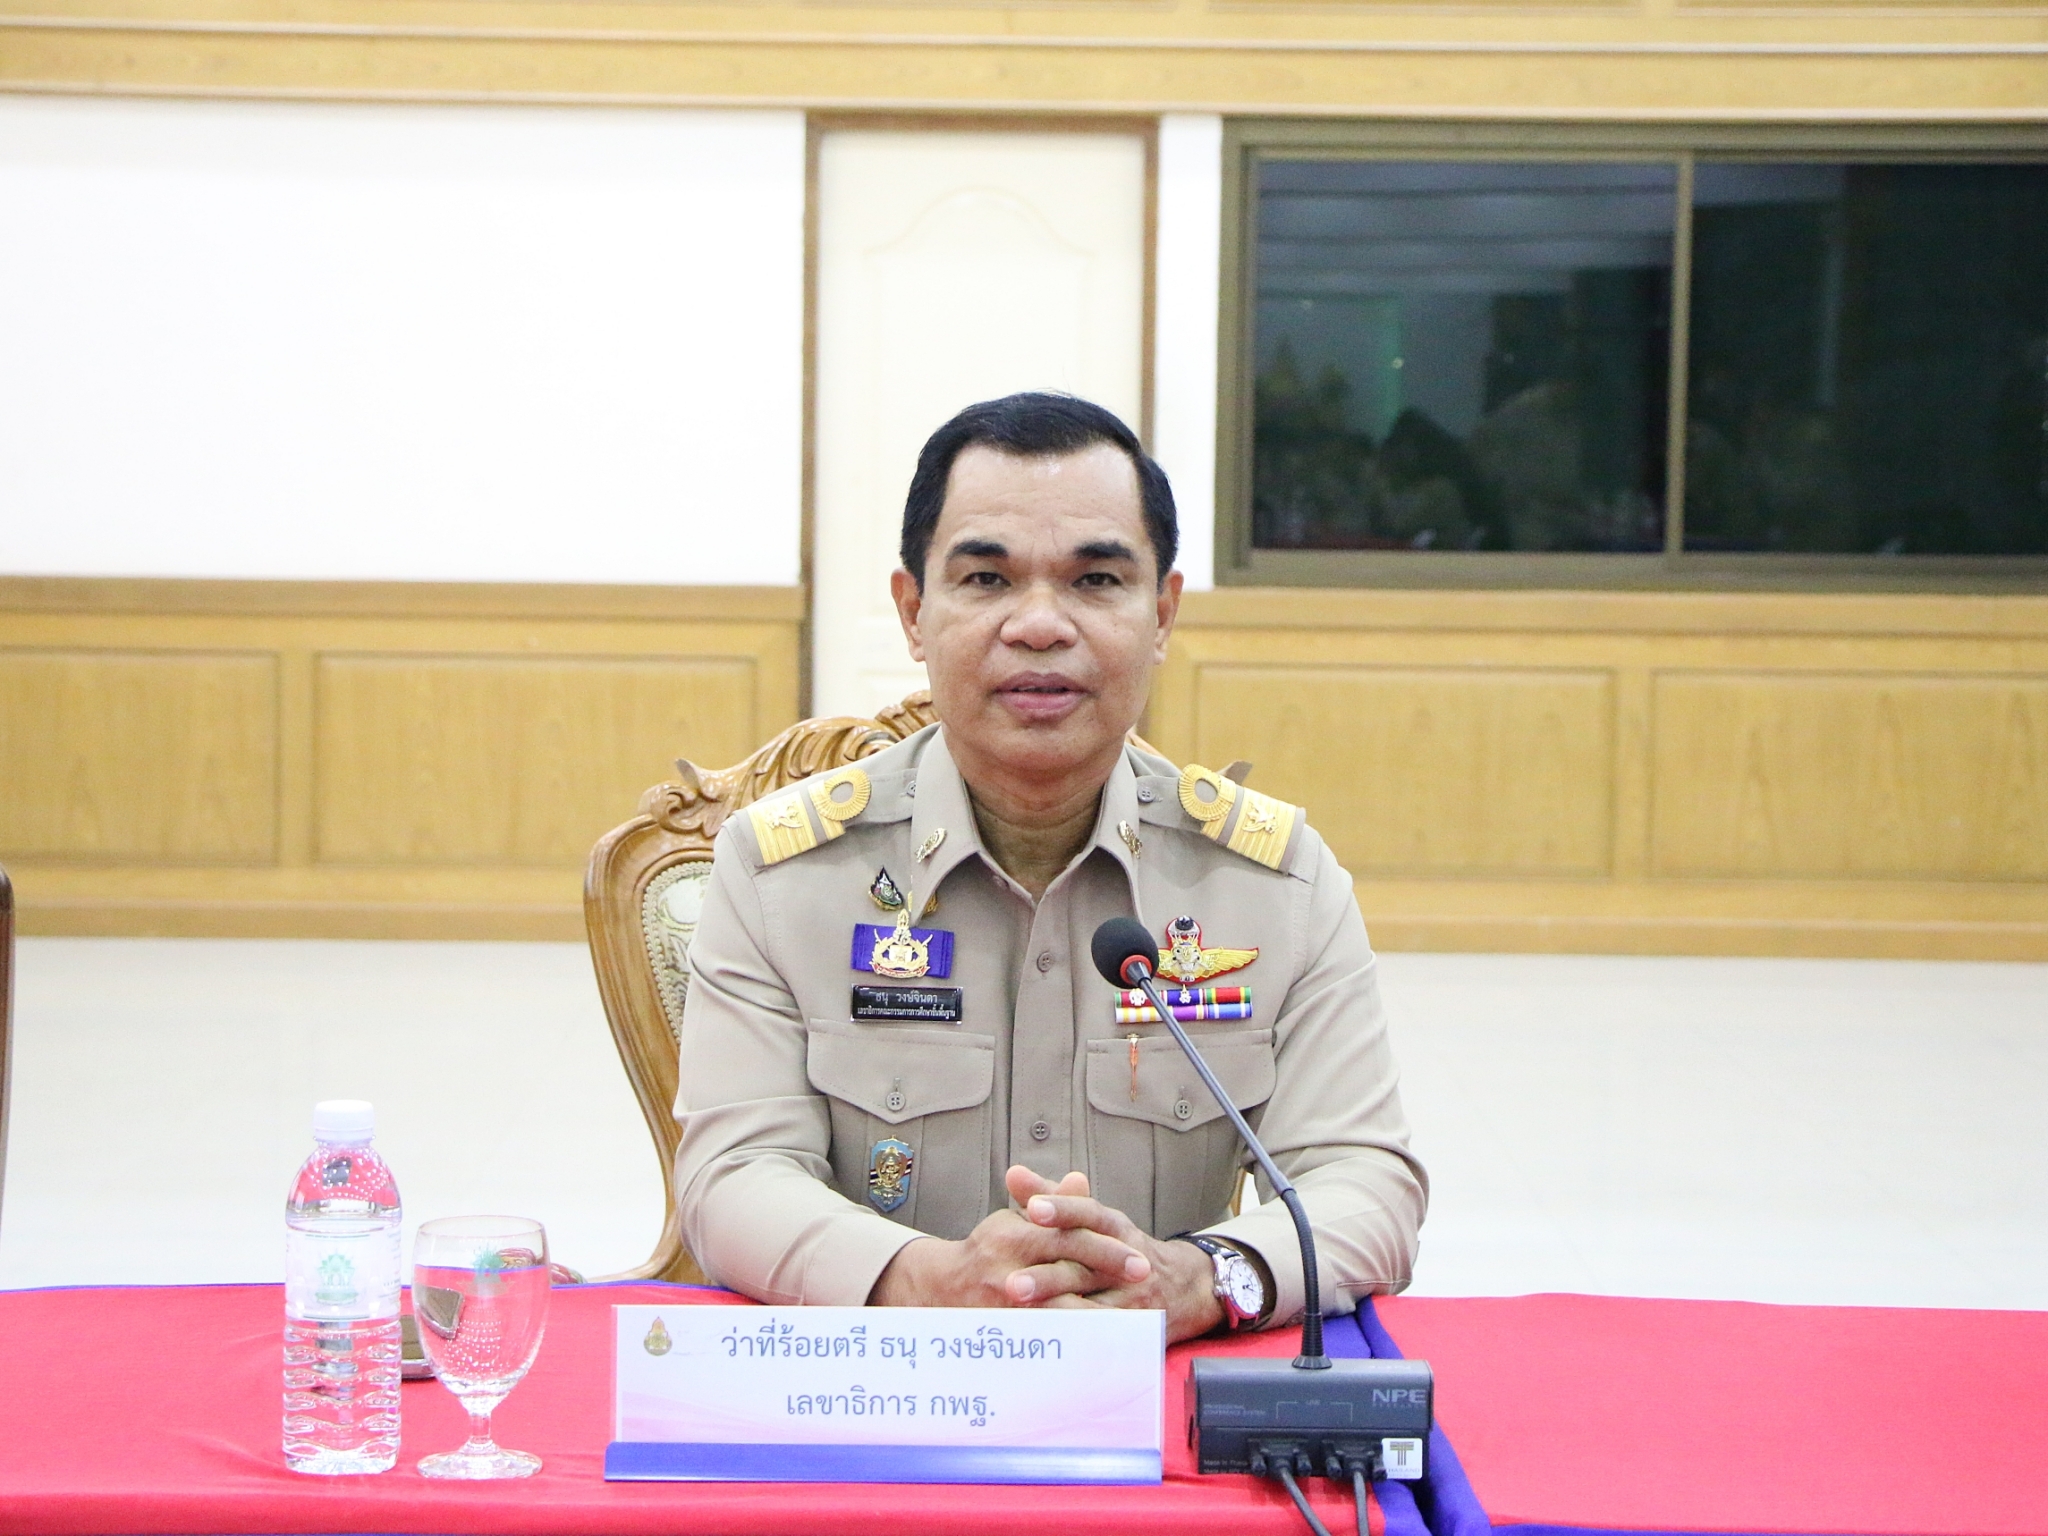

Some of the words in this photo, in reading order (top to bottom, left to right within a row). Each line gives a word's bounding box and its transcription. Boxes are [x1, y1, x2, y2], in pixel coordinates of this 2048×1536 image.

[875, 991, 889, 1006] ธนุ
[896, 990, 938, 1004] วงษ์จินดา
[721, 1317, 868, 1358] ว่าที่ร้อยตรี
[880, 1336, 917, 1370] ธนุ
[930, 1325, 1062, 1359] วงษ์จินดา
[787, 1384, 918, 1416] เลขาธิการ
[930, 1395, 996, 1427] กพฐ.
[1372, 1388, 1427, 1404] NPE
